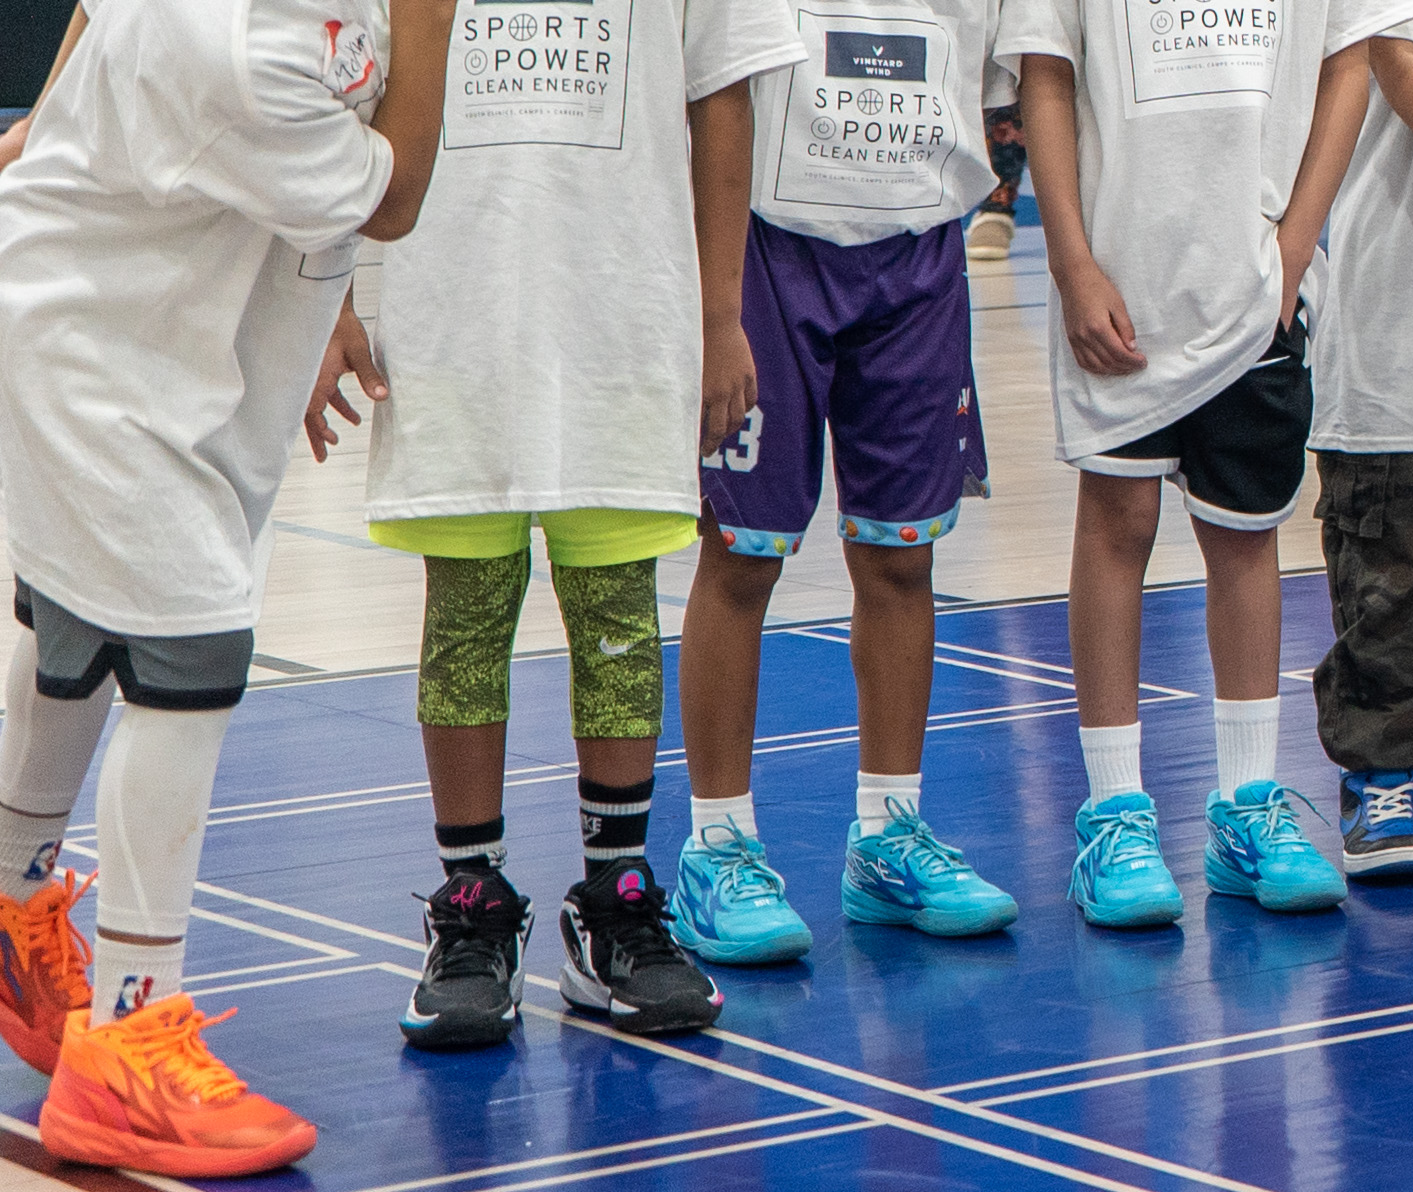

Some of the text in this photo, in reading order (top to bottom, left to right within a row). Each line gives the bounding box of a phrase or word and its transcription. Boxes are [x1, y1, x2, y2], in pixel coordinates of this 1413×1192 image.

[464, 13, 611, 42] SPORTS
[1180, 8, 1277, 32] POWER
[1153, 34, 1276, 53] CLEAN ENERGY
[495, 48, 611, 75] POWER
[853, 57, 903, 68] VINEYARD
[866, 67, 891, 76] WIND
[464, 77, 608, 96] CLEAN ENERGY
[814, 87, 943, 116] SPORTS
[842, 120, 945, 146] POWER
[807, 143, 935, 163] CLEAN ENERGY
